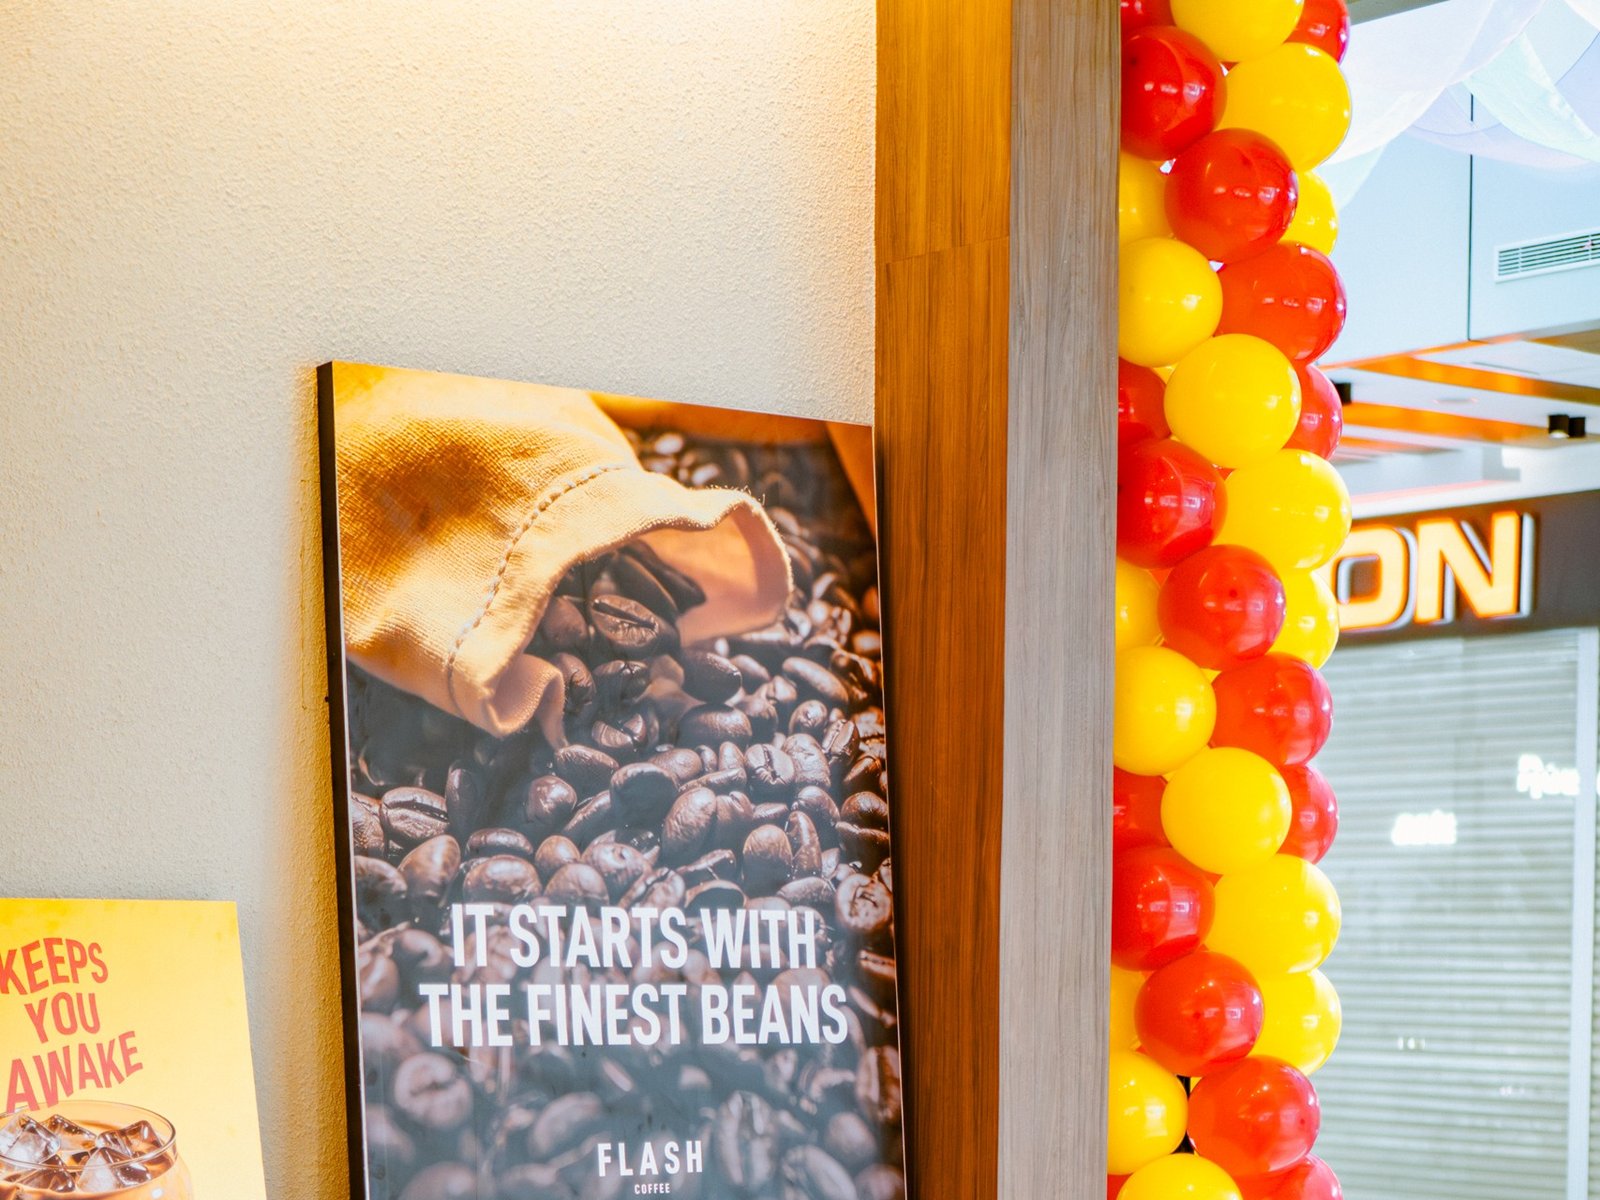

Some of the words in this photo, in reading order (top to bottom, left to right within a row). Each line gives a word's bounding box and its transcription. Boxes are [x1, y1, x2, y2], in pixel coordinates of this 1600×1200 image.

[451, 904, 493, 967] IT
[509, 905, 688, 968] STARTS
[702, 908, 816, 969] WITH
[0, 937, 109, 996] KEEPS
[24, 992, 101, 1044] YOU
[419, 984, 513, 1047] THE
[527, 984, 687, 1046] FINEST
[701, 984, 848, 1045] BEANS
[6, 1030, 143, 1114] AWAKE
[597, 1140, 703, 1177] FLASH
[634, 1183, 671, 1195] COFFEE
